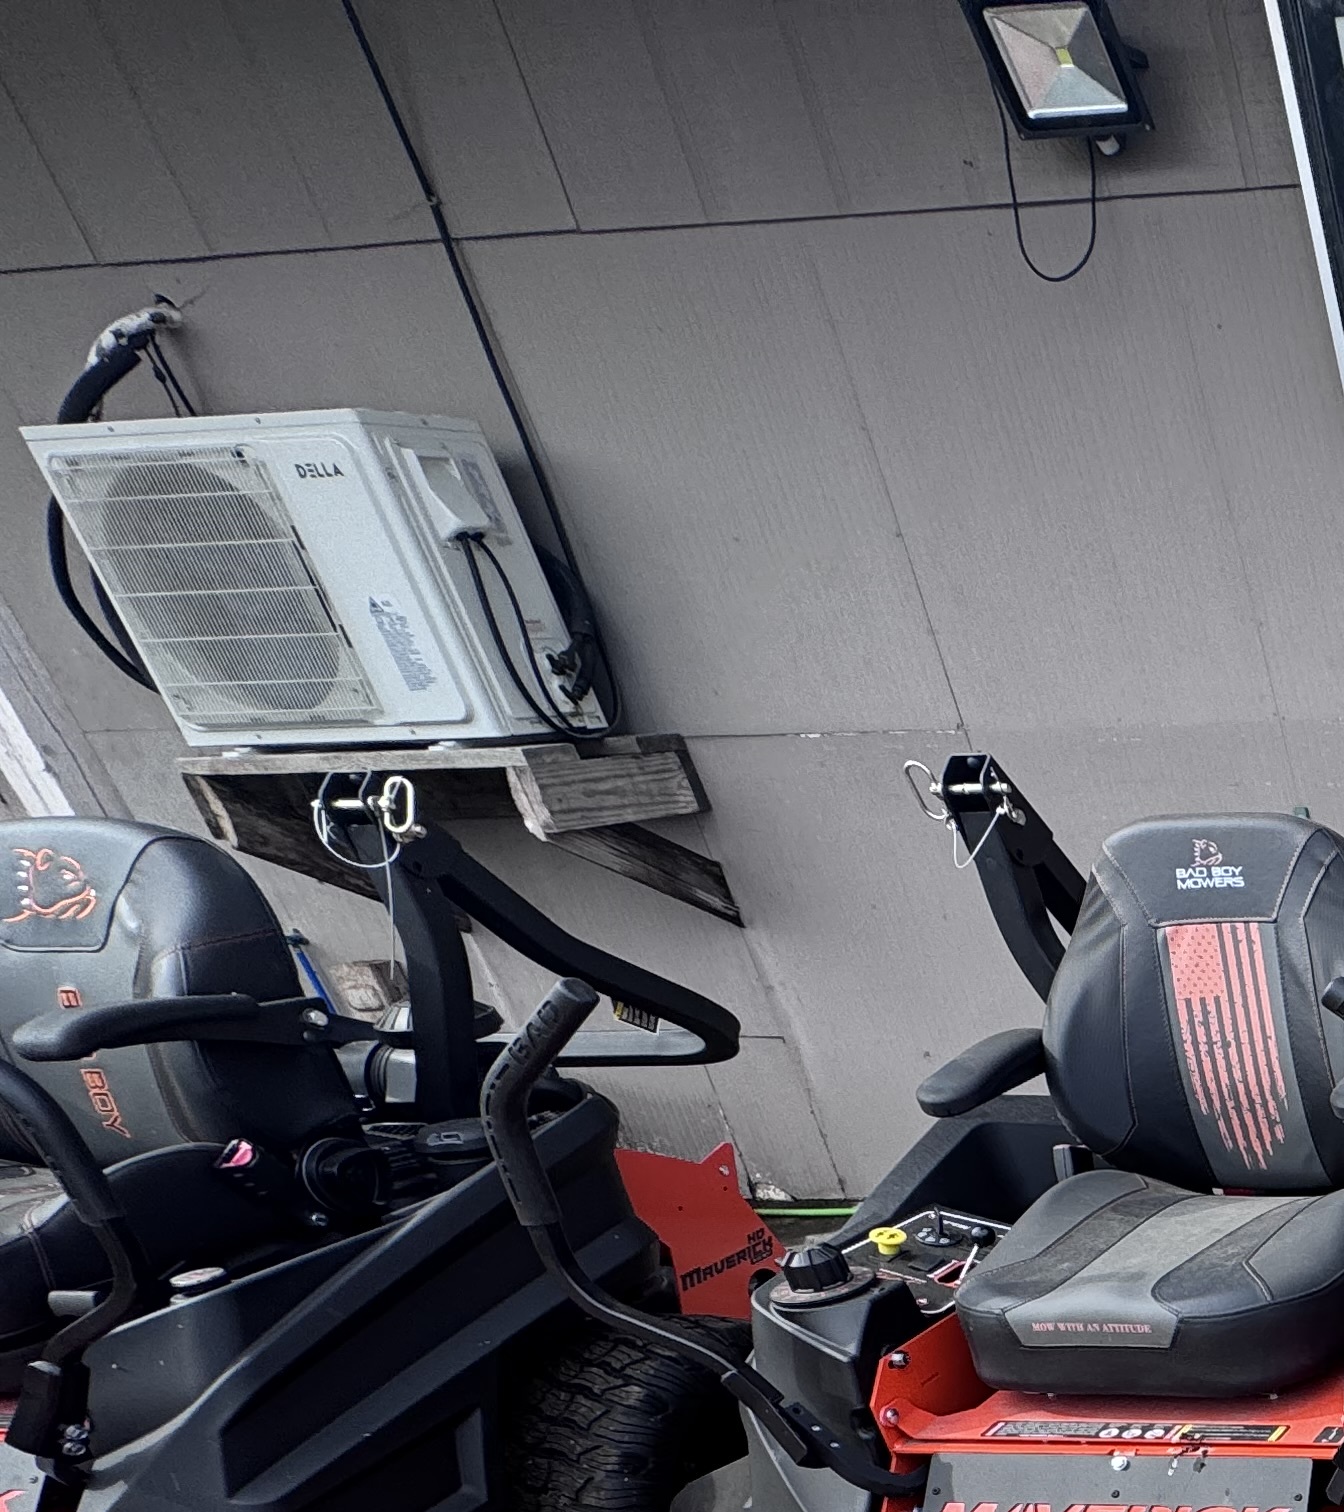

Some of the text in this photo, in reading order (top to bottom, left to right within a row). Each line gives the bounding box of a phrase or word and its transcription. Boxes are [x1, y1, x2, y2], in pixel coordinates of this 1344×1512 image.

[294, 461, 345, 479] DELLA
[1175, 866, 1243, 879] BAD BOY
[1176, 876, 1245, 890] MOWERS
[80, 1068, 132, 1139] BOY
[680, 1235, 774, 1292] MAVERICK
[1031, 1322, 1055, 1332] MOW
